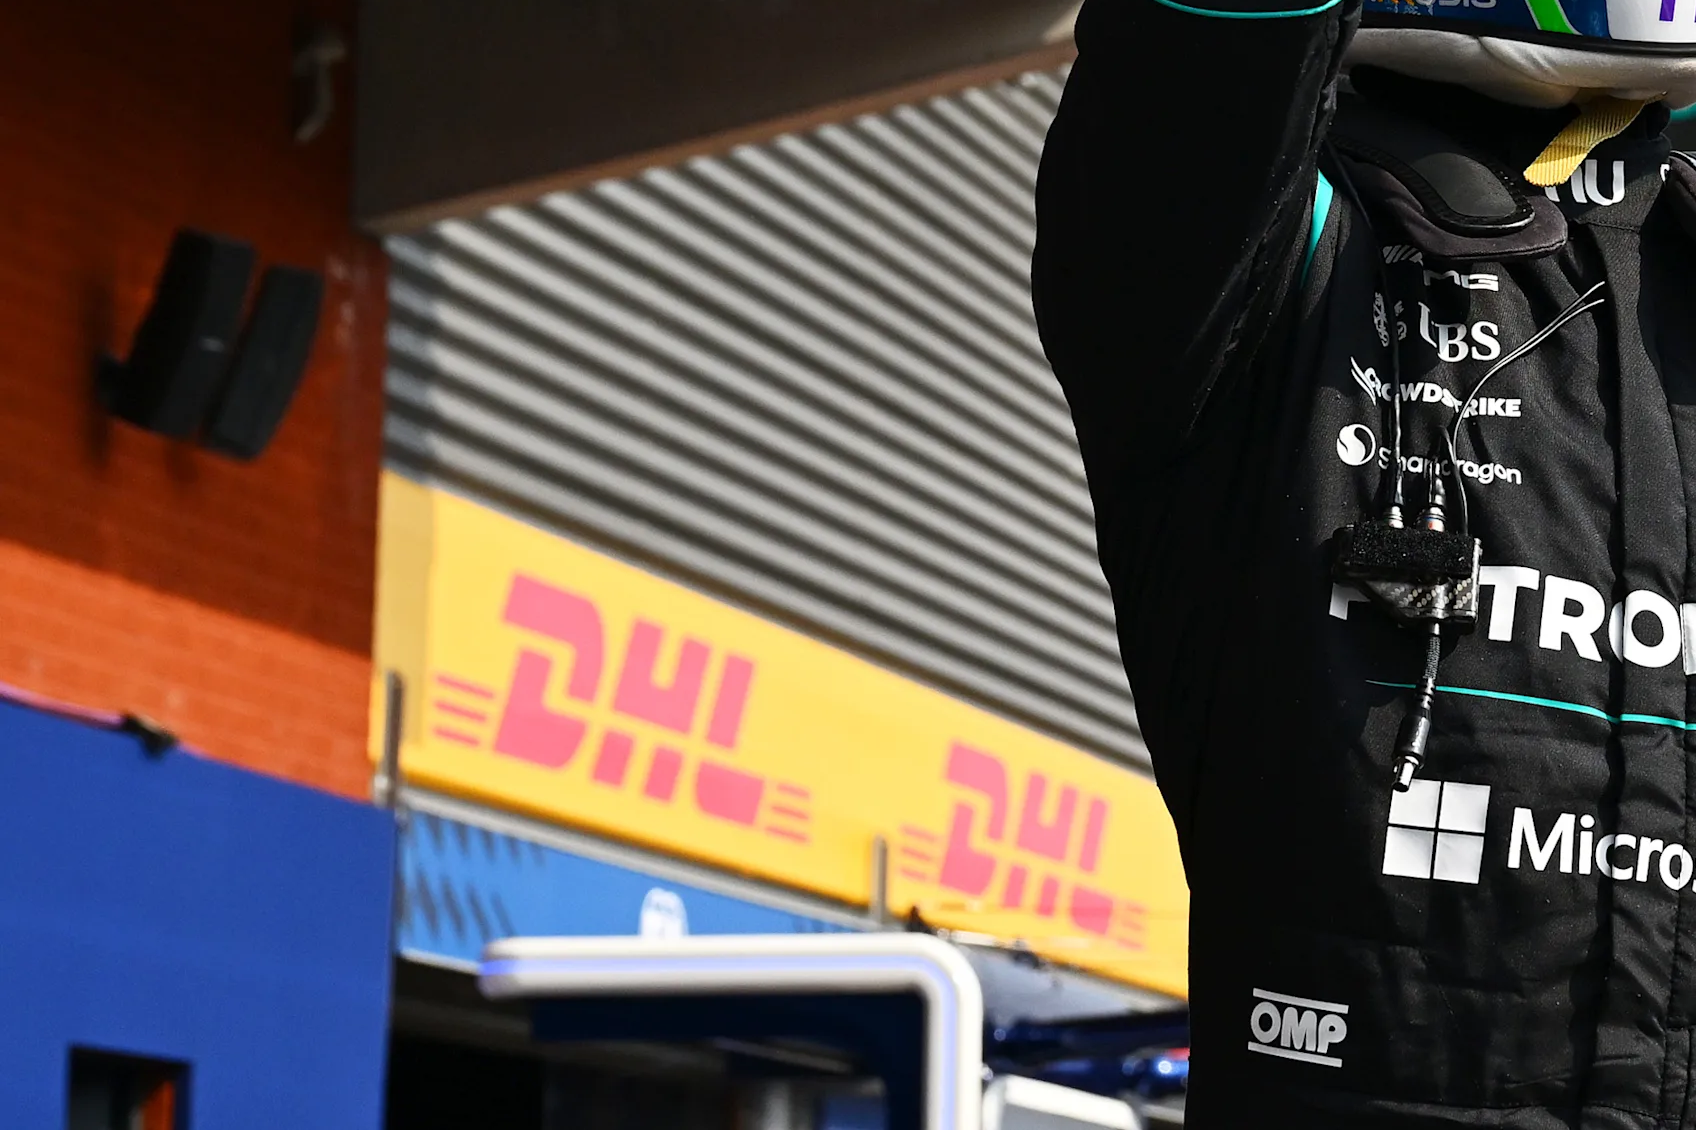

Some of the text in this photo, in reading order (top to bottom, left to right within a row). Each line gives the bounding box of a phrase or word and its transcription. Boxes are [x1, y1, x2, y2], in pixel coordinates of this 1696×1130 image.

[491, 569, 767, 828] DHL
[937, 739, 1116, 937] DHL
[1250, 998, 1348, 1056] OMP
